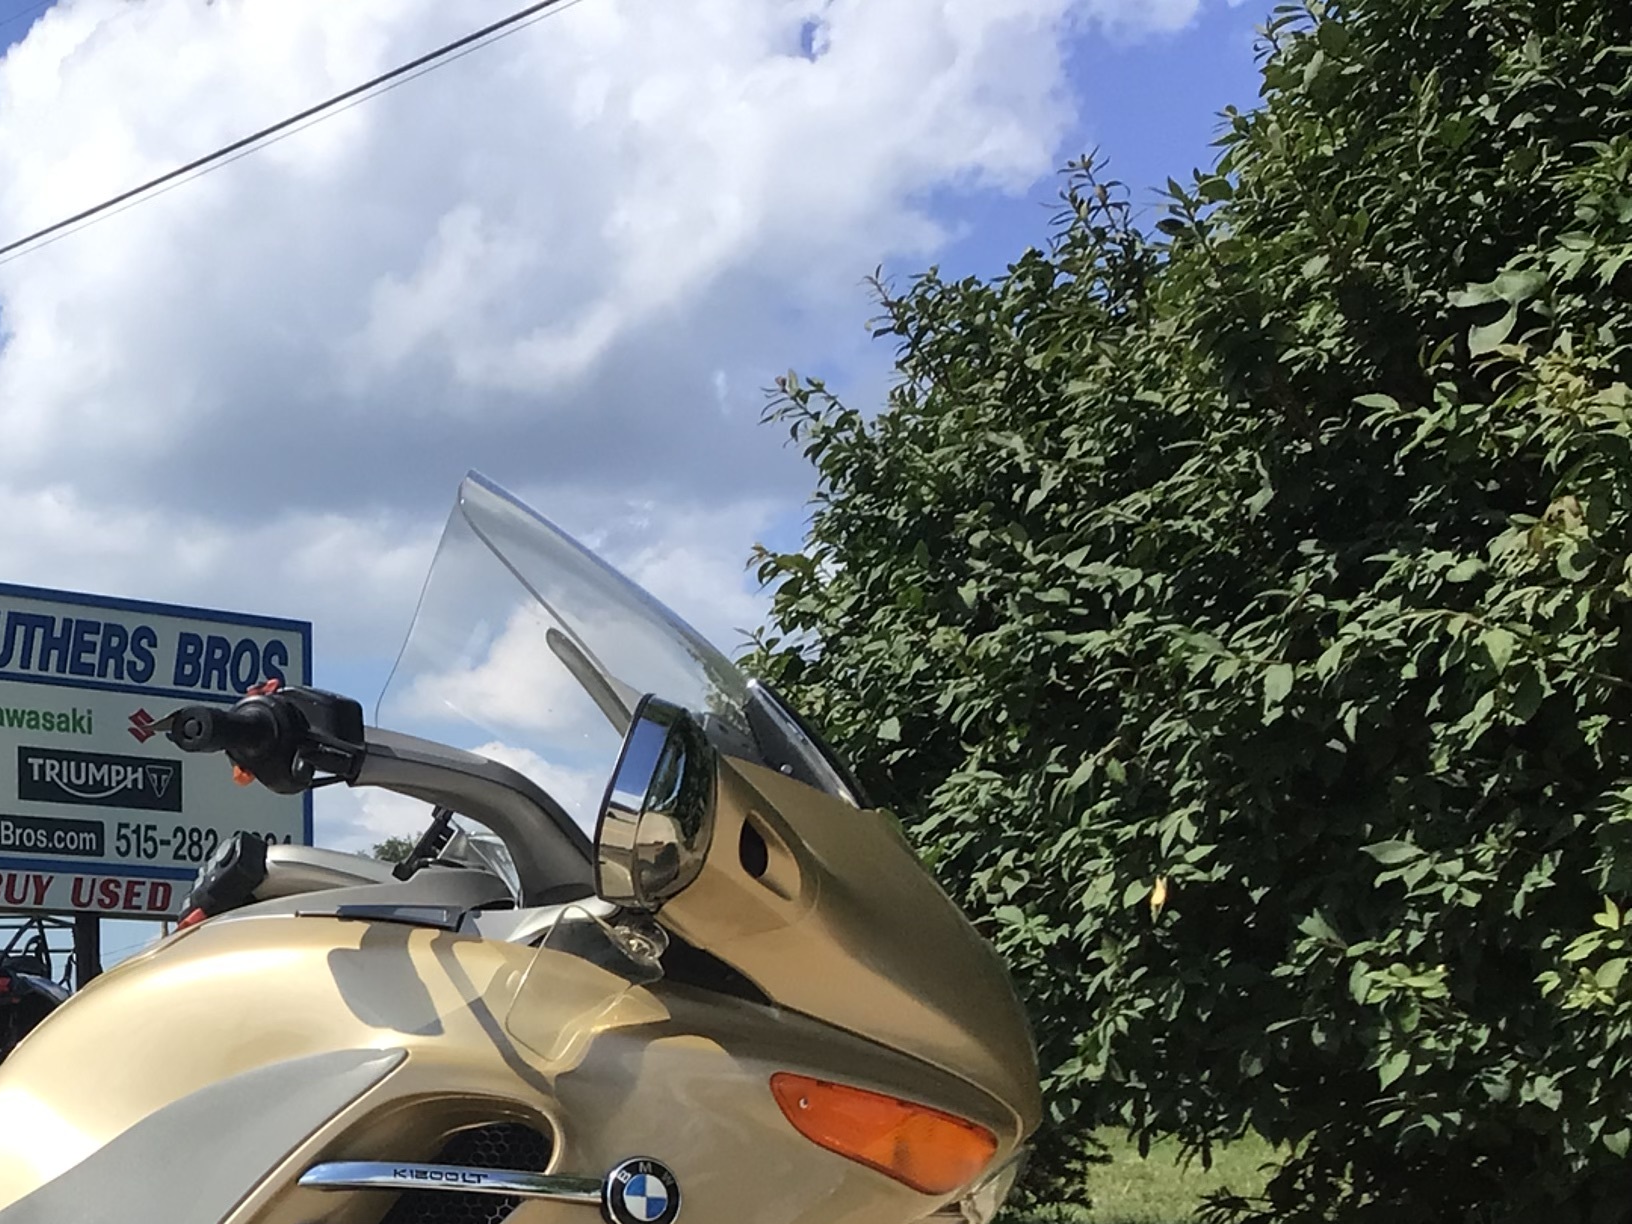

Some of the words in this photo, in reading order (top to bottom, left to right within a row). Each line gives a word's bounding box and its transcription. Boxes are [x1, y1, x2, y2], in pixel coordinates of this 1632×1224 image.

[173, 631, 288, 694] BROS
[27, 757, 144, 798] TRIUMPH
[71, 877, 173, 912] USED
[617, 1161, 675, 1187] BMW
